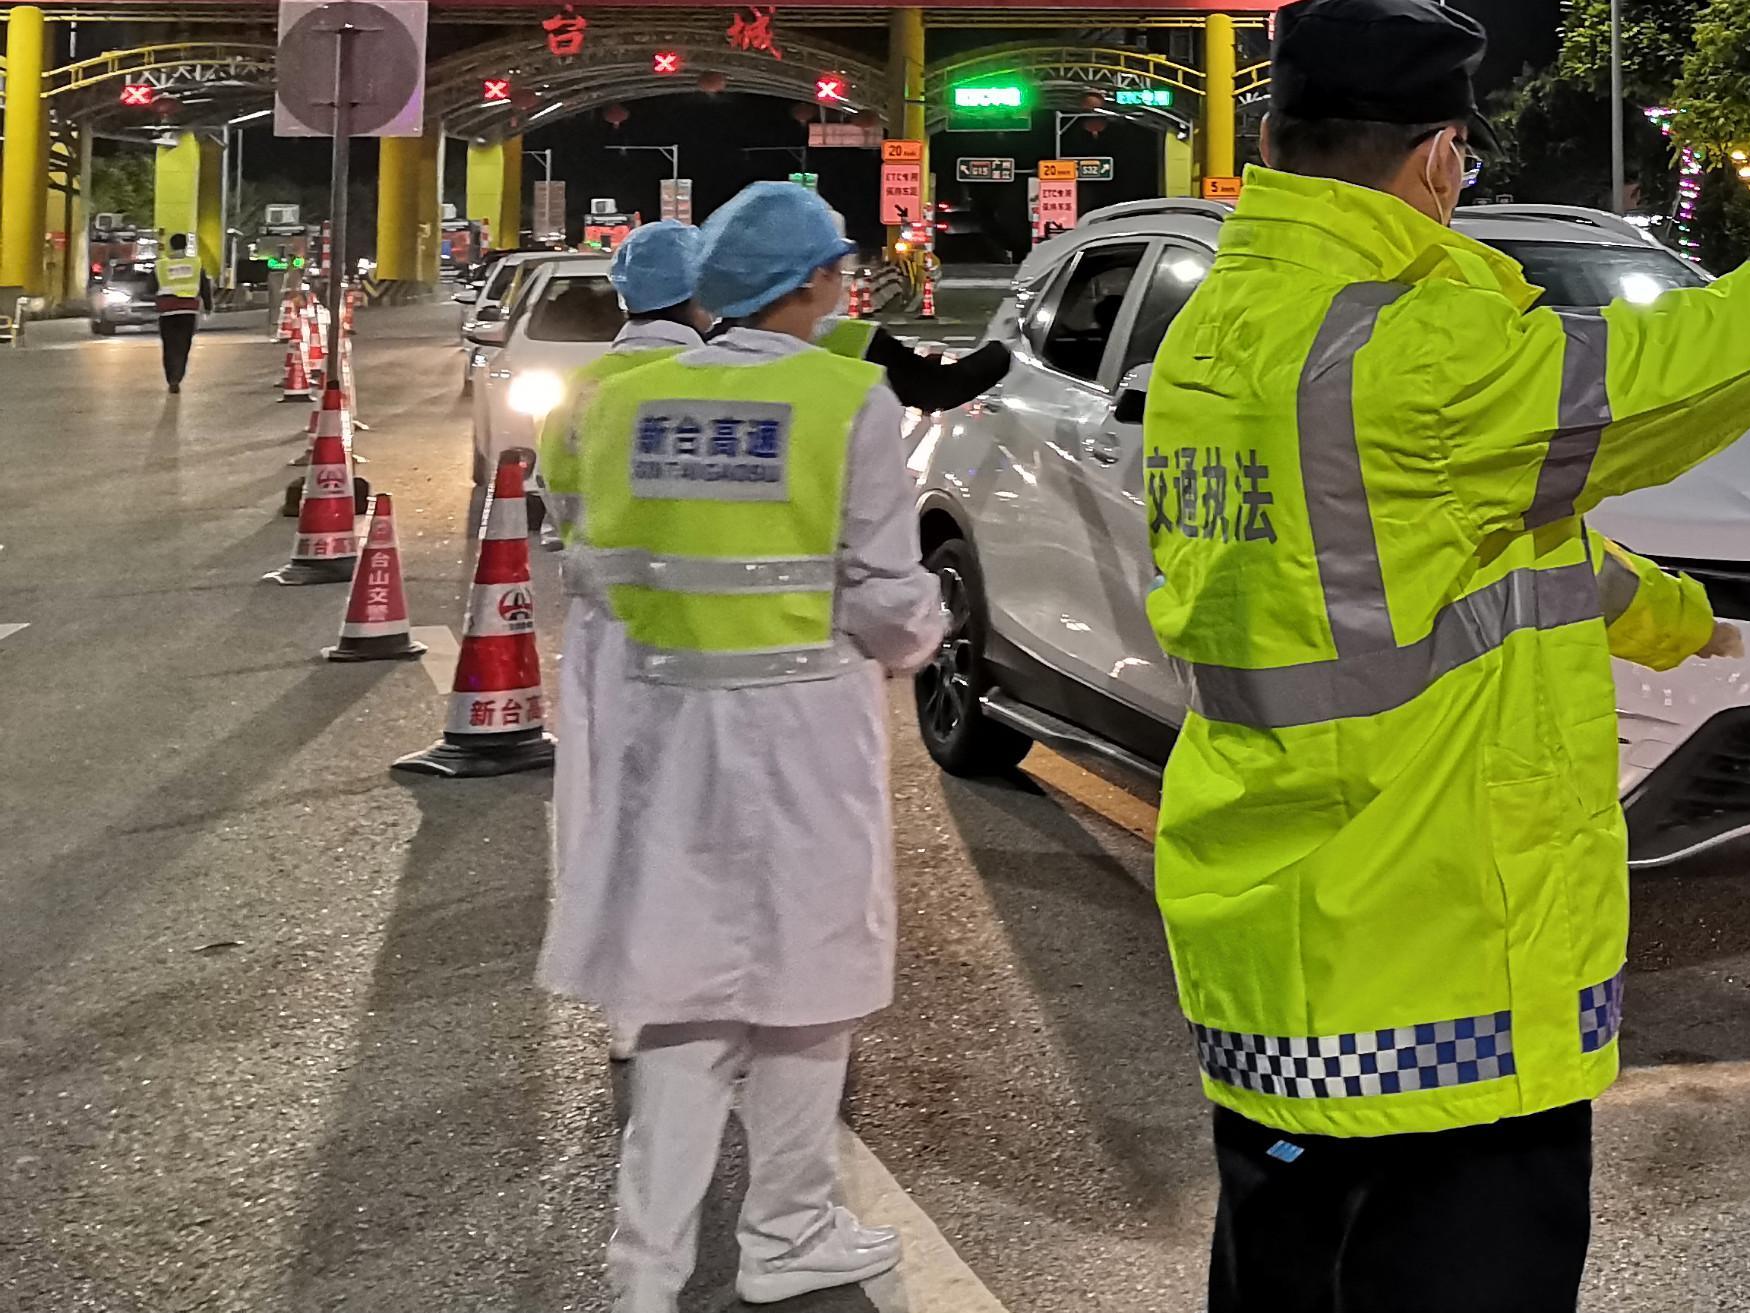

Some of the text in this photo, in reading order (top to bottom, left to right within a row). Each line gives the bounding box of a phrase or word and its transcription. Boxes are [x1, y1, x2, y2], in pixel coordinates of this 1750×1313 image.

[888, 144, 902, 157] 20
[1044, 165, 1056, 176] 20
[1082, 165, 1098, 175] S32
[1211, 181, 1218, 193] 5
